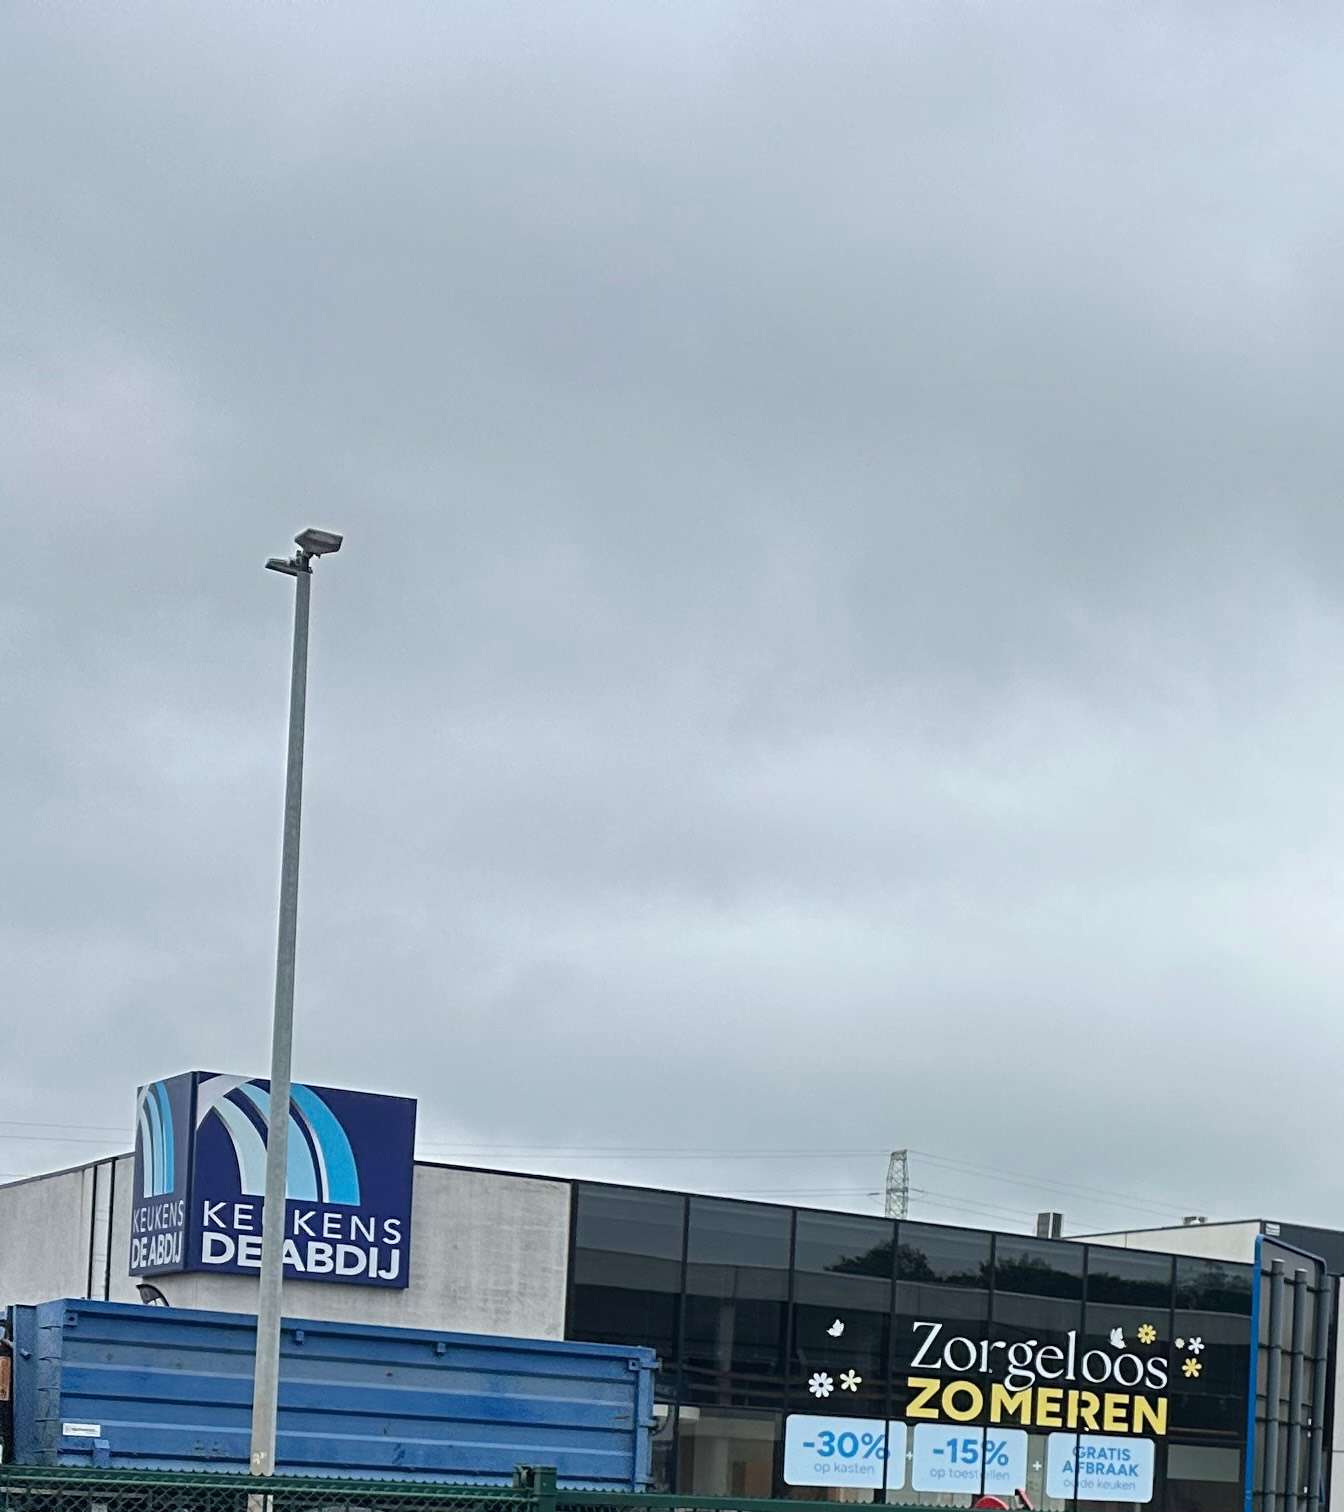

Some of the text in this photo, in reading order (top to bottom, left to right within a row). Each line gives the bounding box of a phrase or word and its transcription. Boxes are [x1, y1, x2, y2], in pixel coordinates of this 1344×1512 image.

[132, 1200, 185, 1233] KEUKENS
[203, 1200, 402, 1245] KEKENS
[148, 1231, 184, 1266] ABDIJ
[281, 1238, 400, 1281] ABDIJ
[910, 1321, 1168, 1391] Zorgeloos
[905, 1376, 1168, 1436] ZOMEREN
[802, 1430, 891, 1460] -30%
[932, 1438, 1009, 1466] -15%
[1072, 1446, 1131, 1461] GRATIS
[814, 1462, 875, 1475] op kasten
[929, 1468, 946, 1480] op
